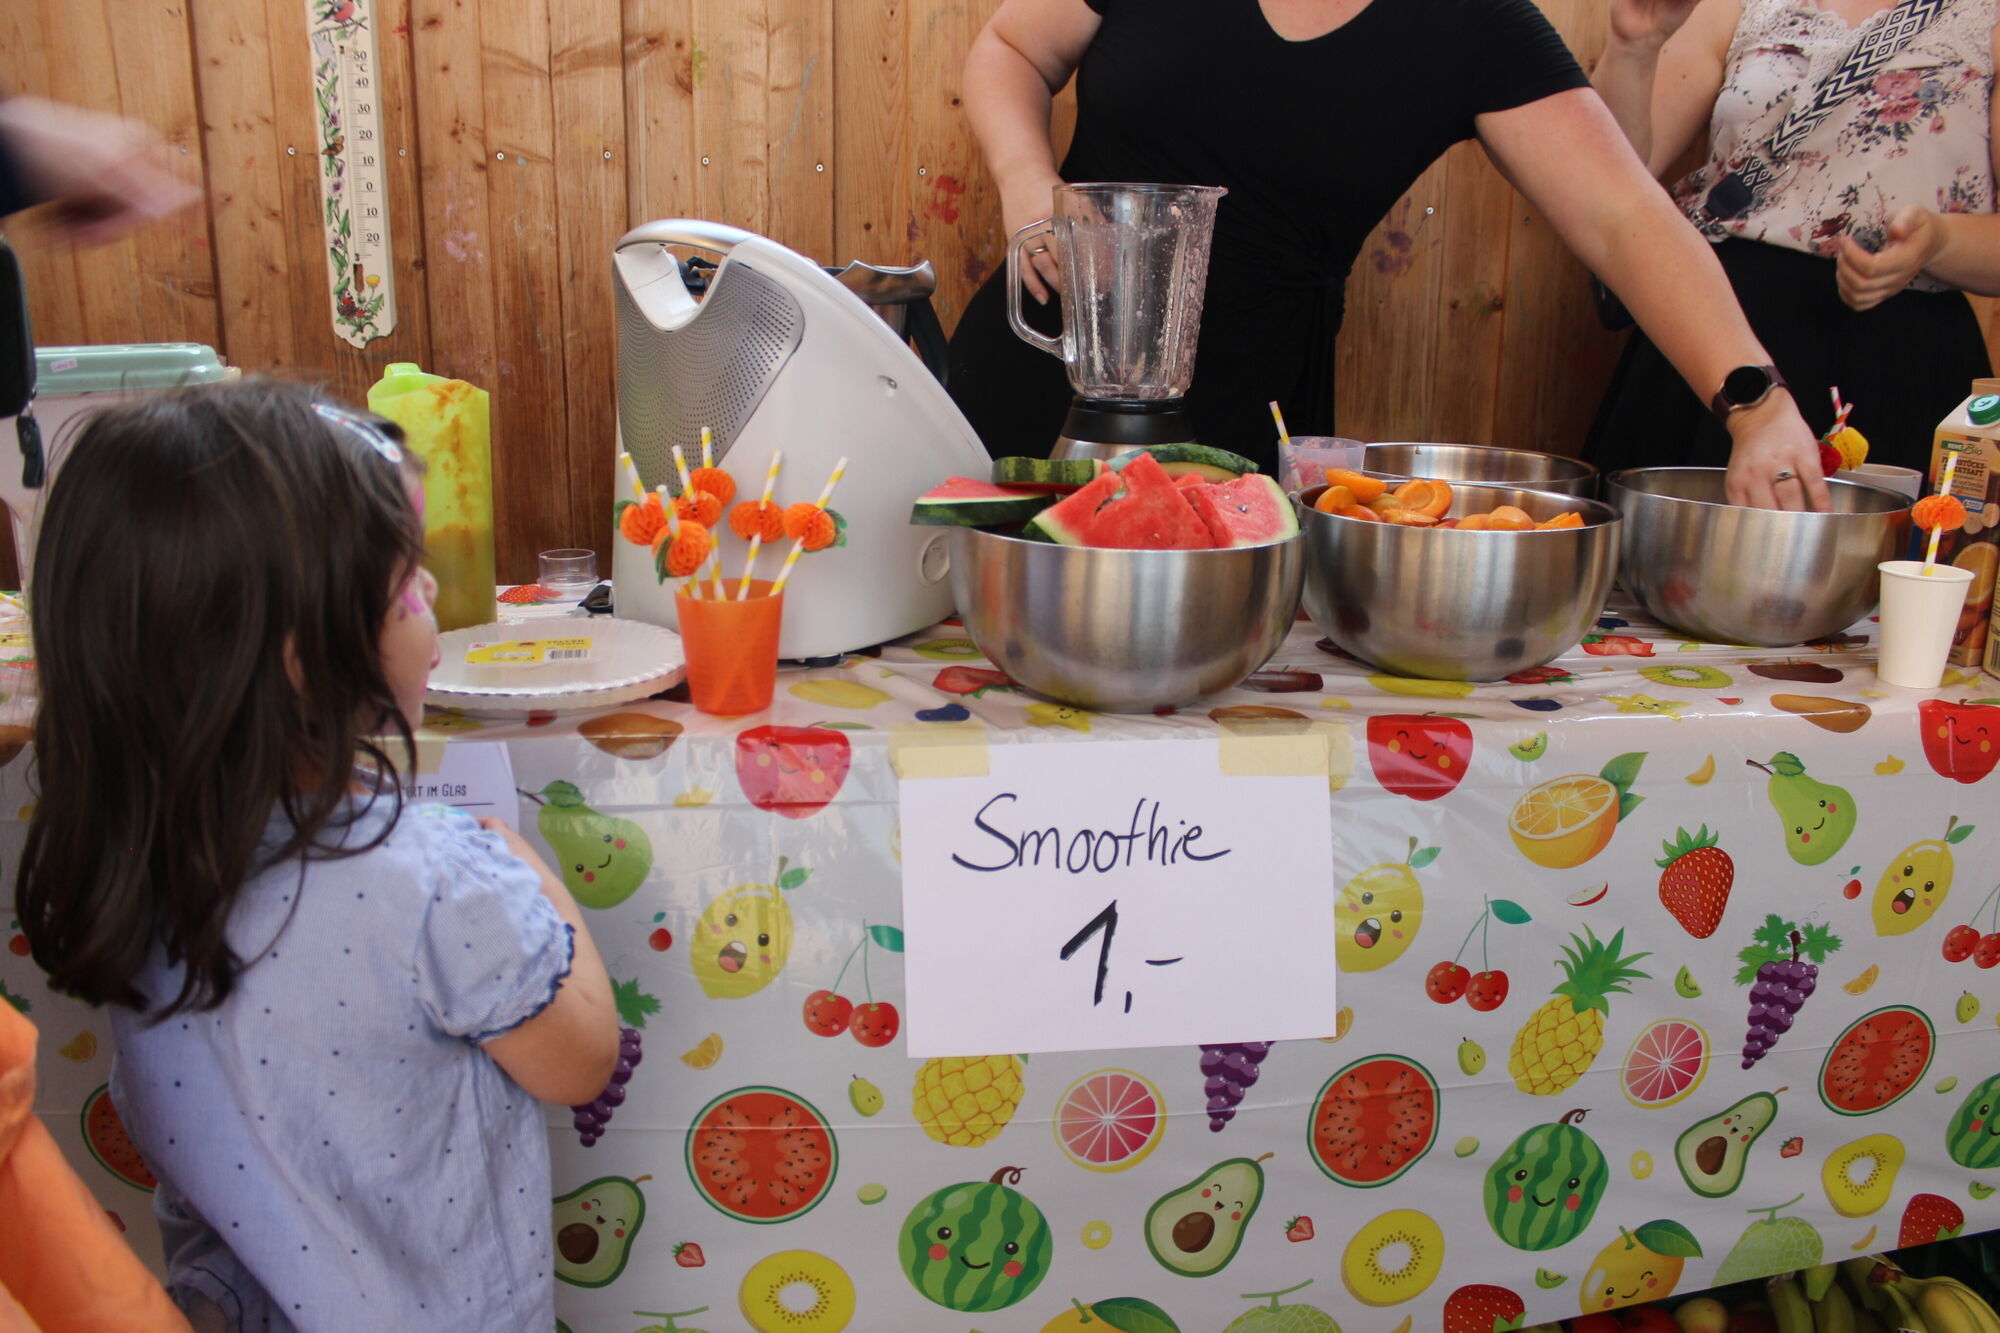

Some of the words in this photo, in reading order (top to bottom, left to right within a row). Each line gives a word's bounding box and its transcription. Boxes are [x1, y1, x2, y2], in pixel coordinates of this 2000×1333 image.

[355, 77, 369, 87] 40
[357, 103, 371, 114] 30
[358, 129, 373, 140] 20
[362, 155, 375, 166] 10
[366, 181, 373, 191] 0
[366, 207, 378, 217] 10
[366, 232, 380, 242] 20
[427, 785, 438, 797] IM
[441, 783, 467, 797] GLAS
[951, 792, 1232, 874] Smoothie
